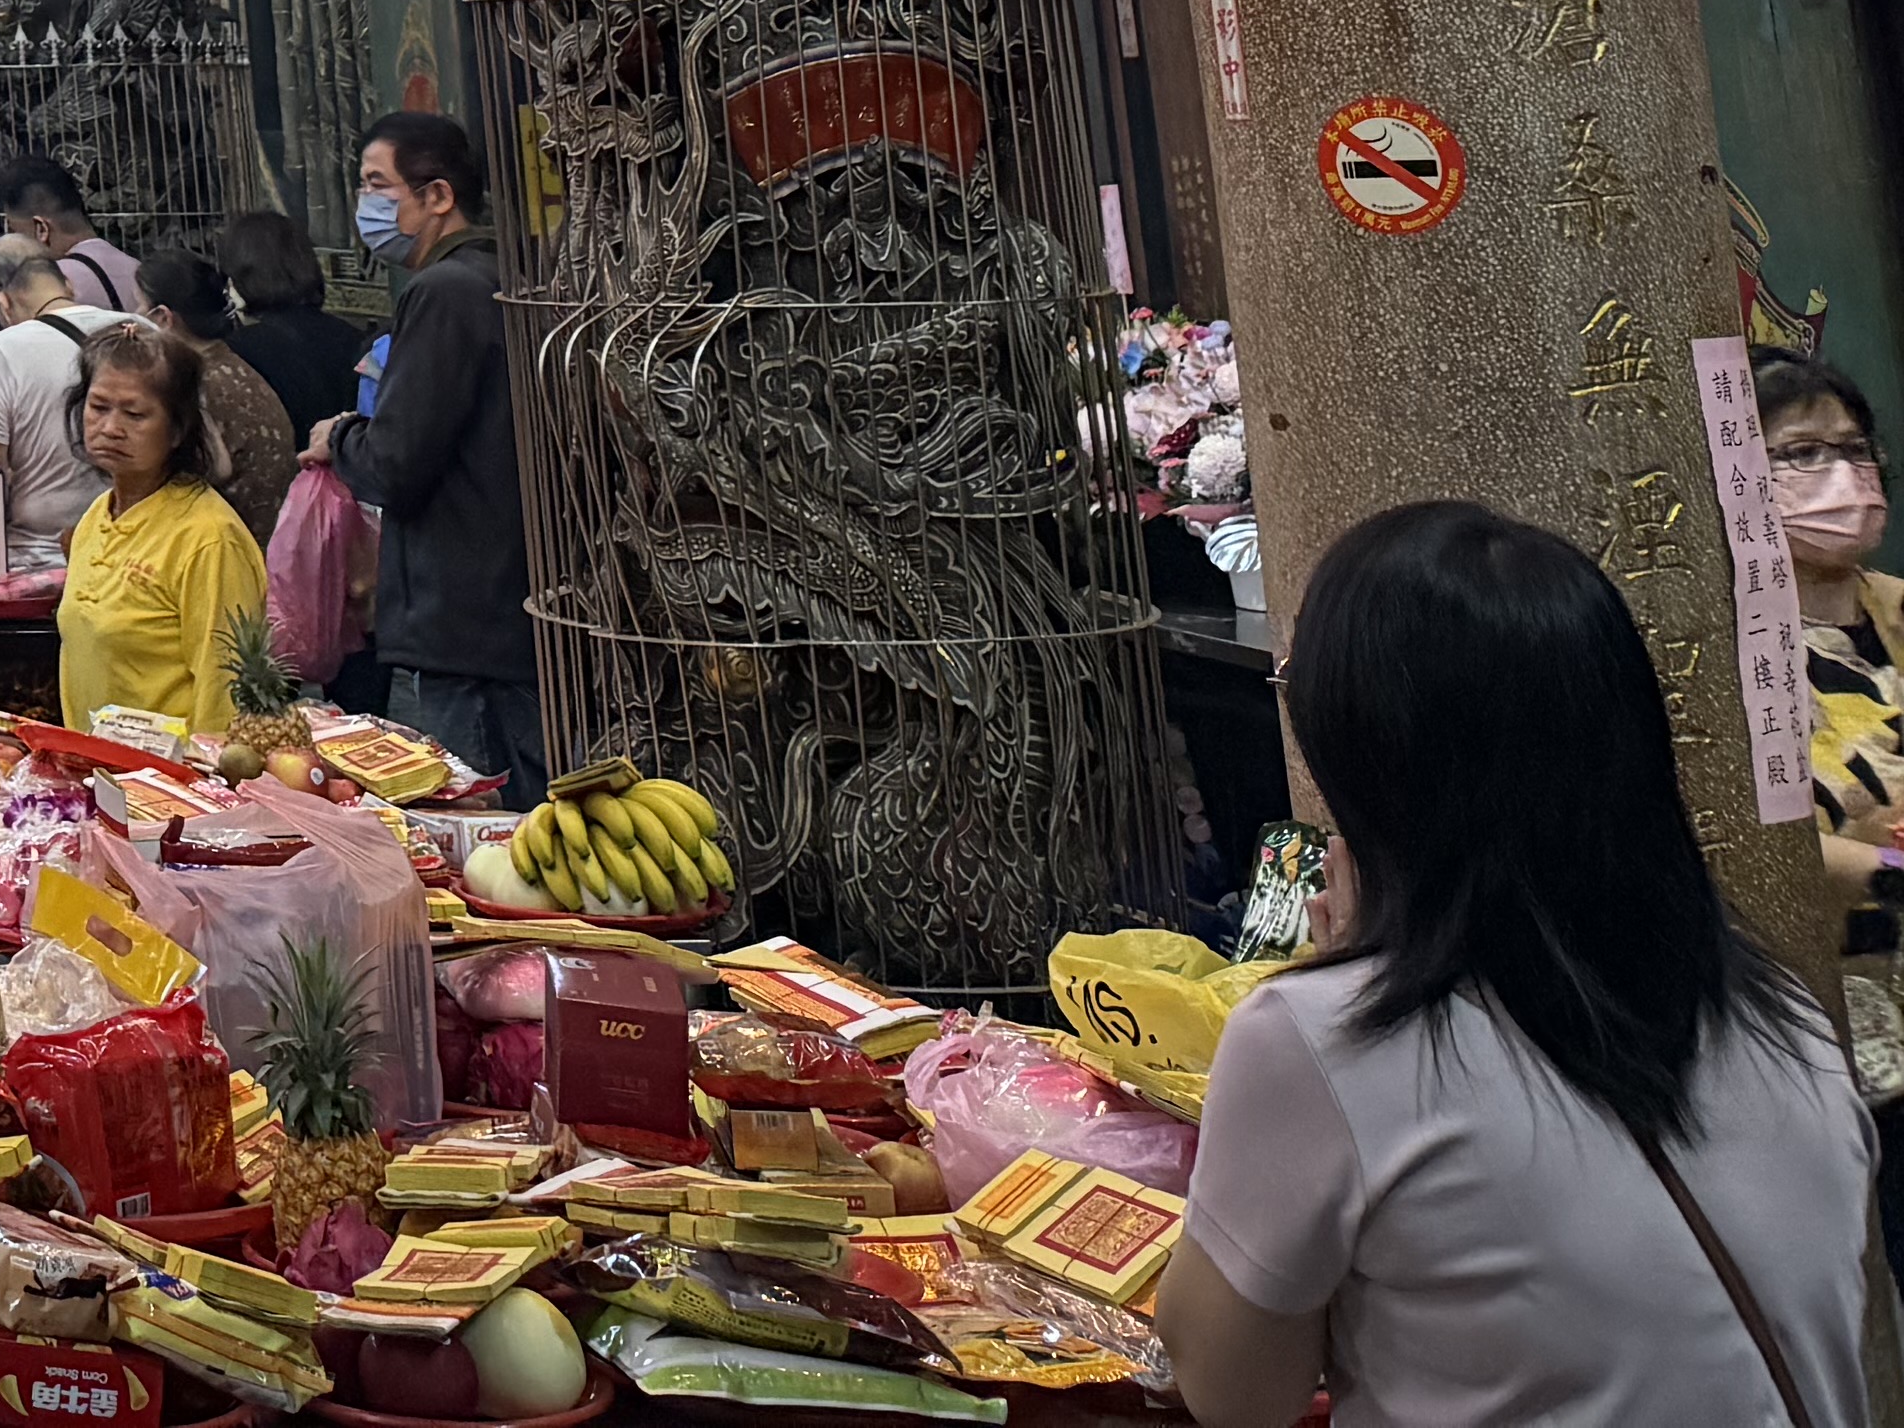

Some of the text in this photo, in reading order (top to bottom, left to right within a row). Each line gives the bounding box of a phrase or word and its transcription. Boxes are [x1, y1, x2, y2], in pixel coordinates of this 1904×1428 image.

[45, 1365, 109, 1385] Corn Snack
[31, 1380, 119, 1419] 金牛角
